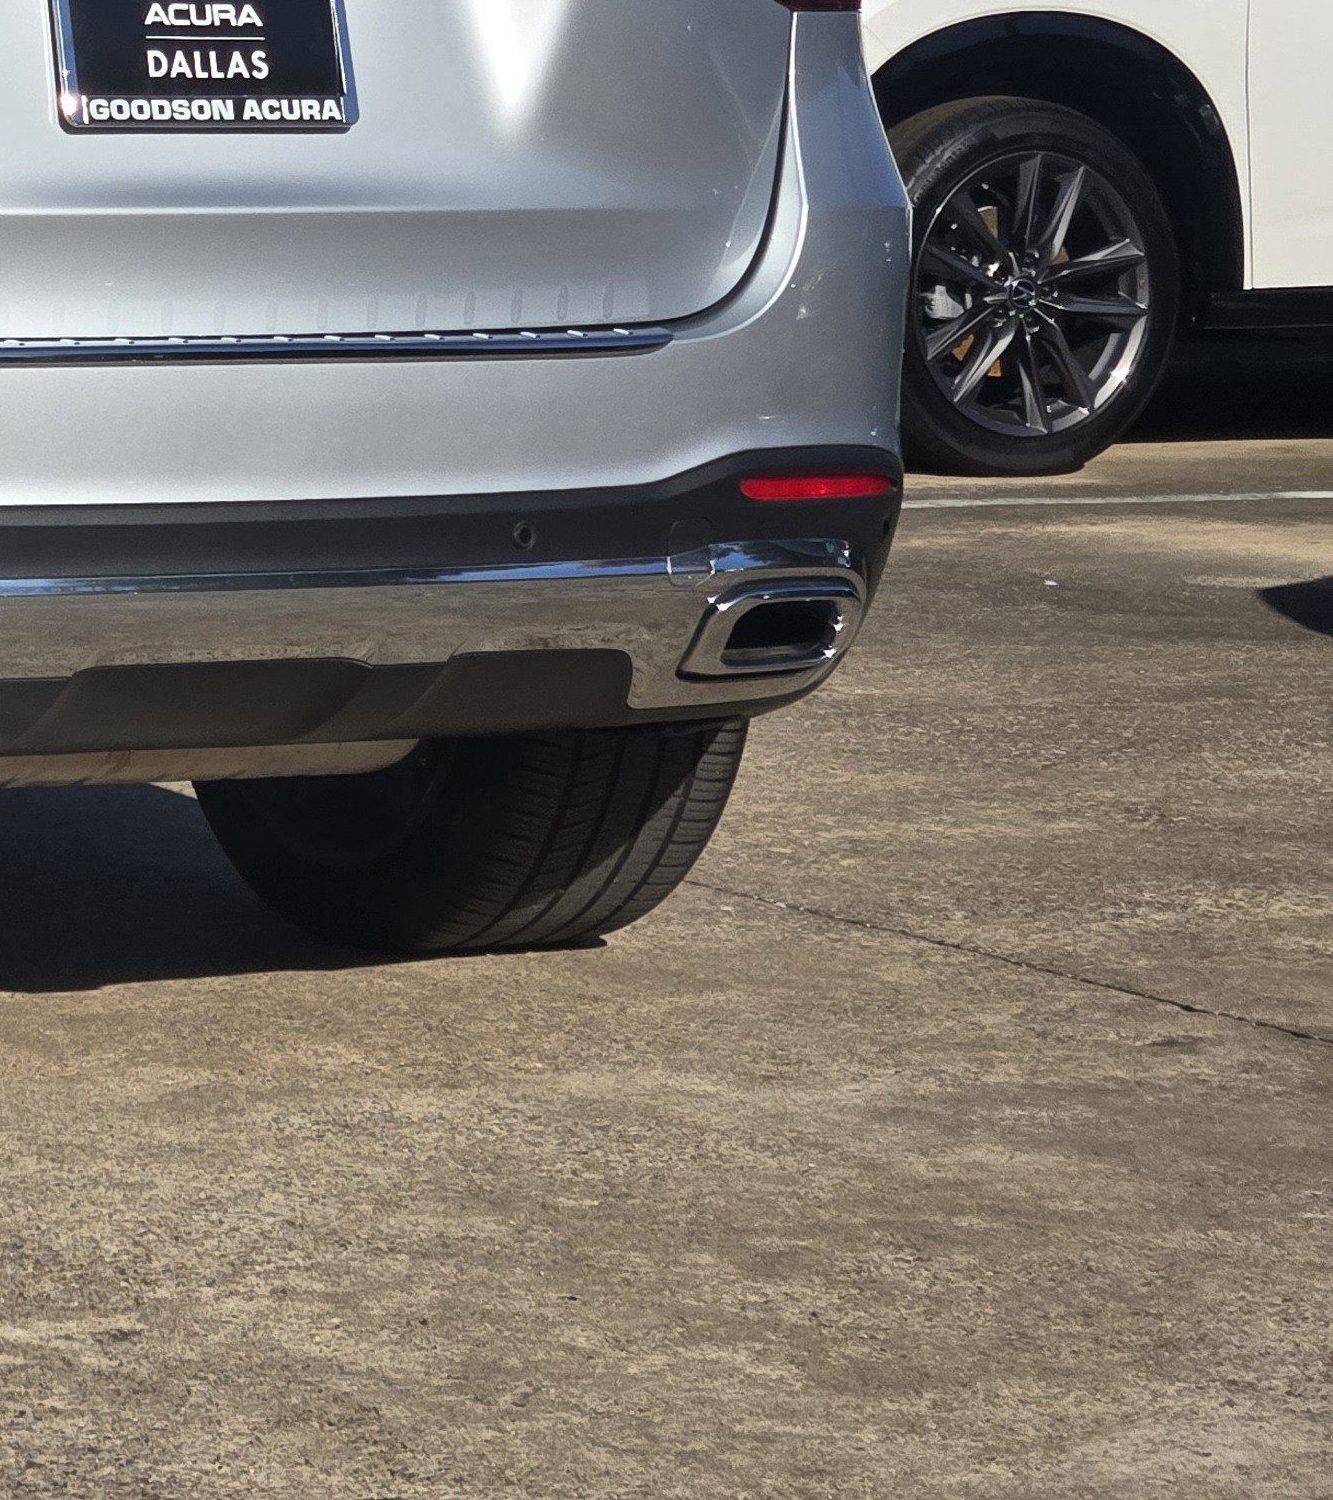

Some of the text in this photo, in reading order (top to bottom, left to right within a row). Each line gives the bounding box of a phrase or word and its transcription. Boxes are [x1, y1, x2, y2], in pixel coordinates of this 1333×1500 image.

[144, 3, 263, 27] ACURA
[146, 50, 269, 80] DALLAS
[90, 98, 343, 122] GOODSON ACURA
